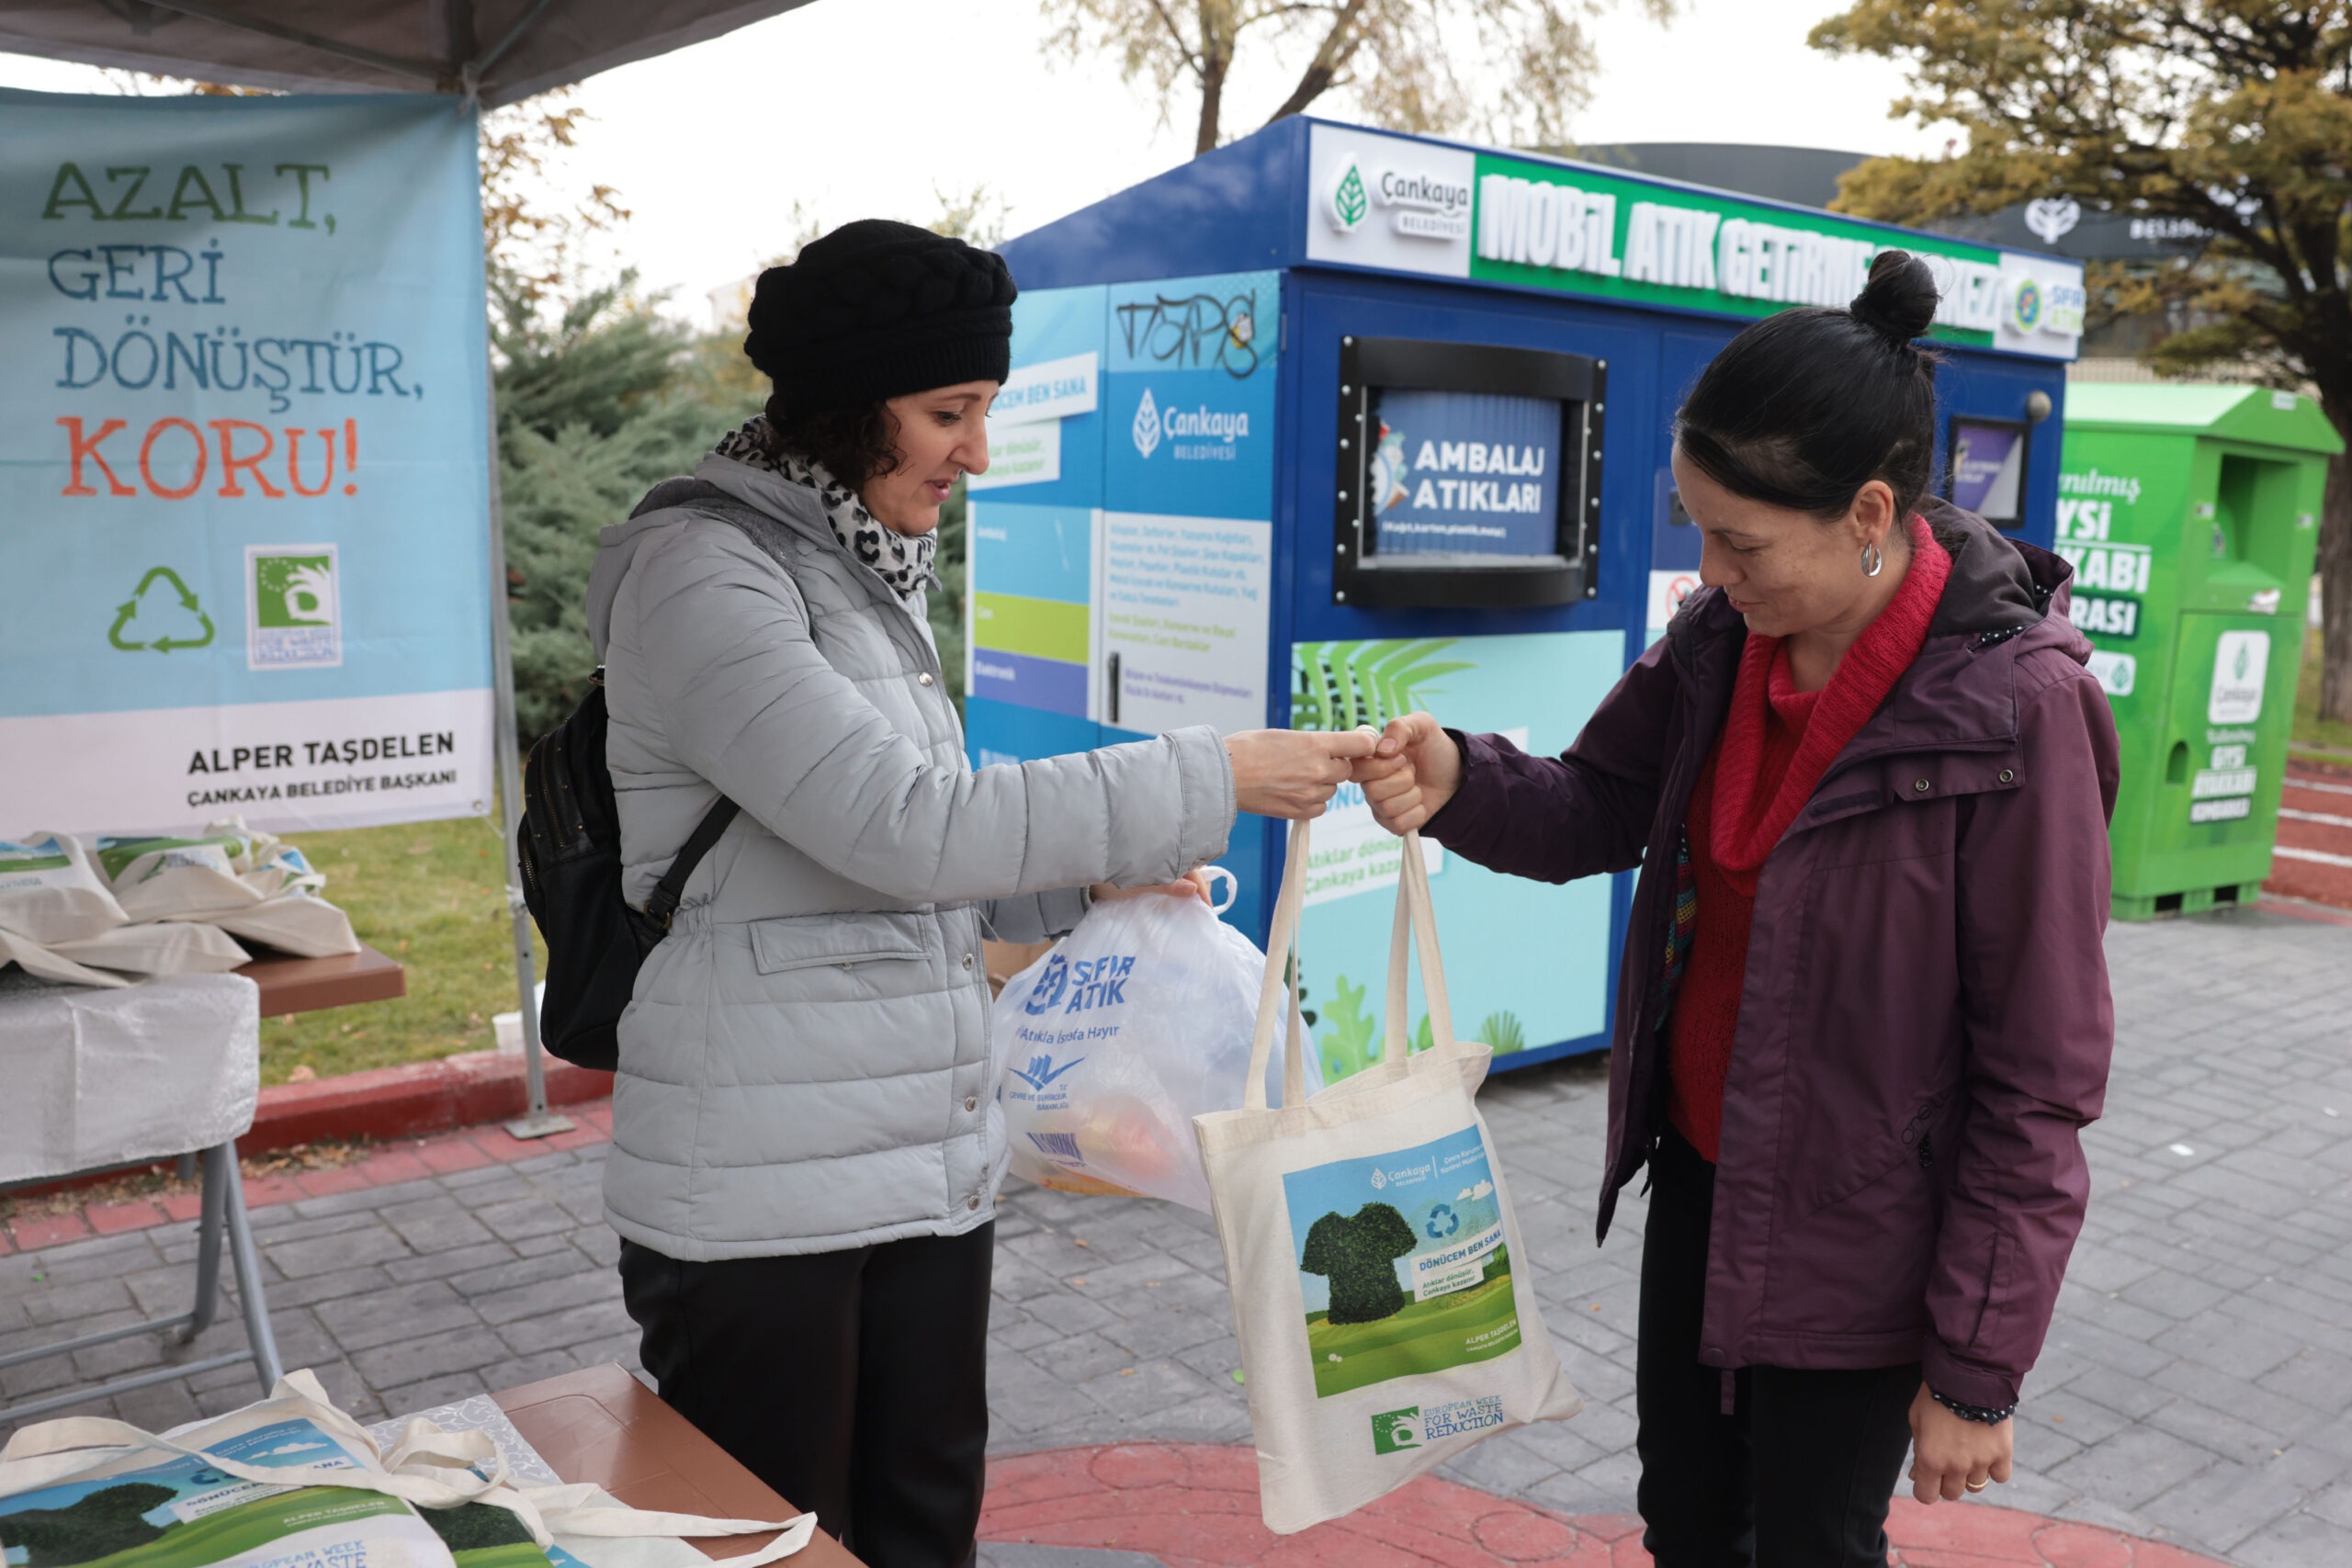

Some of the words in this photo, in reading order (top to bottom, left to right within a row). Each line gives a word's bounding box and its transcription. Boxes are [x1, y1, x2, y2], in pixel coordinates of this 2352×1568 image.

[42, 161, 336, 235] AZALT,
[1381, 171, 1469, 210] Çankaya
[1477, 173, 1622, 278] MOBİL
[1622, 200, 1722, 290] ATIK
[47, 238, 226, 304] GERİ
[53, 313, 424, 414] DÖNÜŞTÜR,
[1026, 382, 1050, 405] BEN
[1053, 374, 1087, 400] SANA
[1162, 403, 1250, 443] Çankaya
[55, 416, 359, 501] KORU!
[1414, 439, 1545, 478] AMBALAJ
[1412, 478, 1542, 514] ATIKLARI
[2055, 497, 2113, 542] YSİ
[2068, 595, 2138, 637] RASI
[187, 744, 293, 774] ALPER
[302, 731, 455, 765] TAŞDELEN
[187, 785, 281, 808] ÇANKAYA
[286, 774, 377, 799] BELEDİYE
[379, 769, 458, 790] BAŞKANI
[1071, 954, 1137, 987] SIFIR
[1064, 976, 1129, 1015] ATIK
[1087, 1025, 1120, 1040] Hayır
[1028, 1093, 1036, 1101] VE
[1387, 1163, 1431, 1182] Çankaya
[1419, 1248, 1466, 1271] DÖNÜCEM
[1467, 1241, 1484, 1256] BEN
[1484, 1229, 1501, 1247] SANA
[1422, 1277, 1444, 1289] Atıklar
[1423, 1283, 1452, 1297] Çankaya
[1465, 1332, 1489, 1345] ALPER
[1489, 1318, 1517, 1338] TAŞDELEN
[1423, 1399, 1473, 1417] EUROPEAN
[1476, 1394, 1502, 1405] WEEK
[1424, 1413, 1452, 1427] FOR
[1456, 1402, 1503, 1420] WASTE
[1425, 1412, 1504, 1440] REDUCTION
[322, 1540, 367, 1556] WEEK
